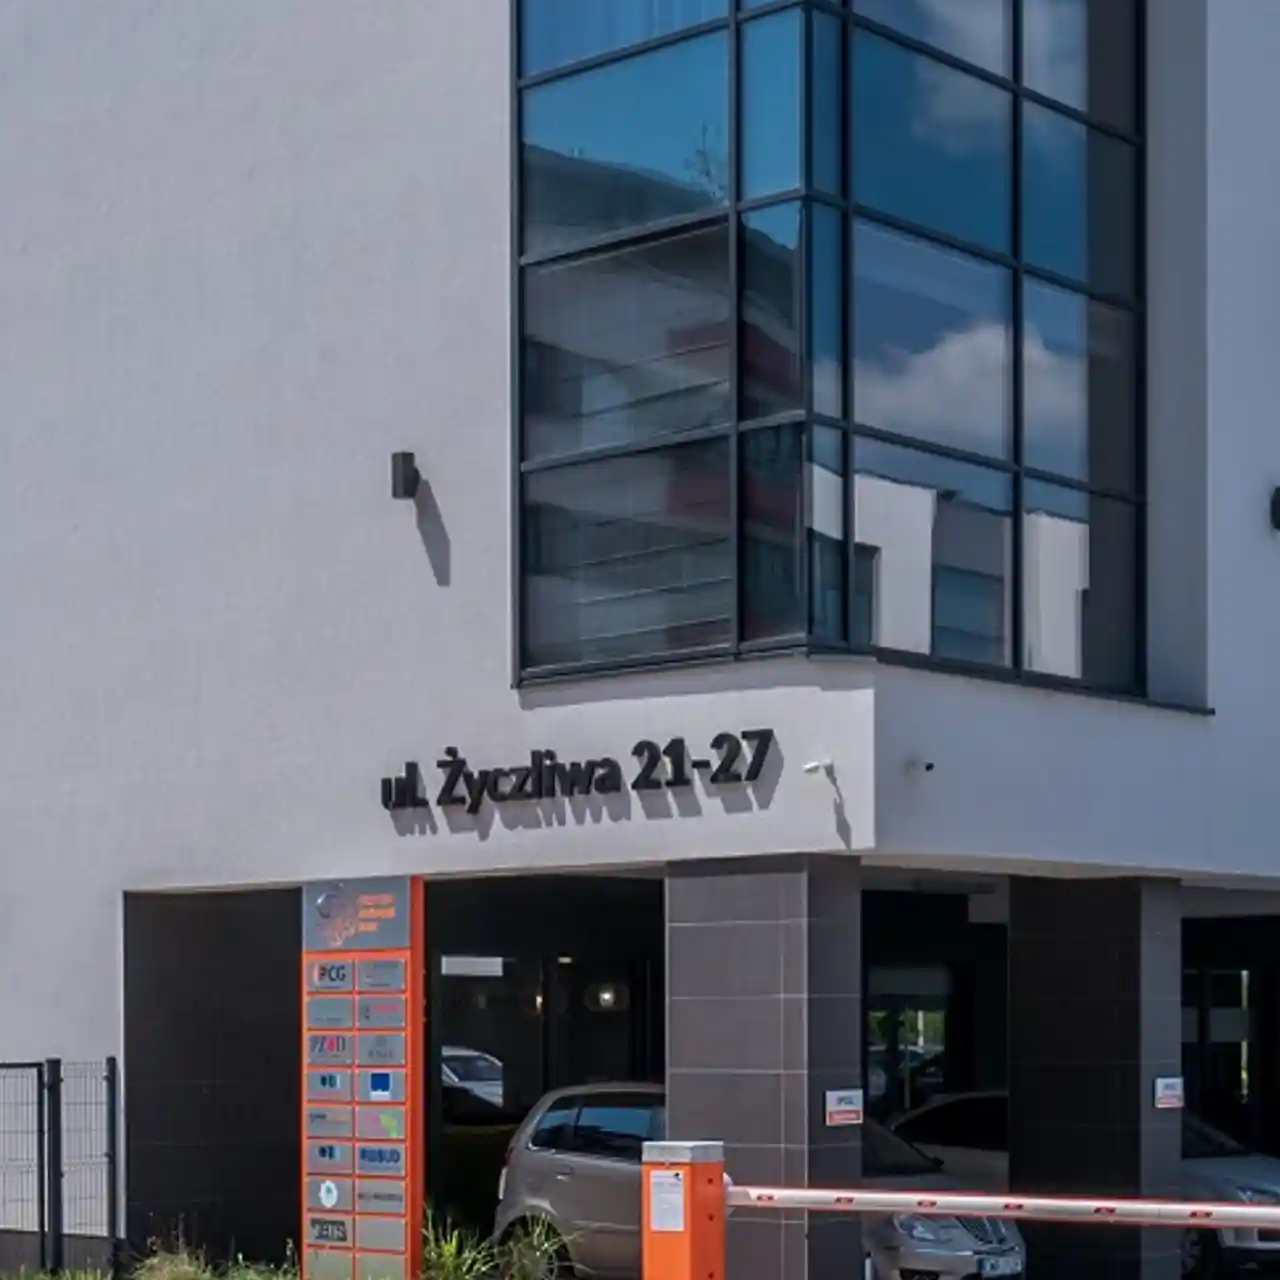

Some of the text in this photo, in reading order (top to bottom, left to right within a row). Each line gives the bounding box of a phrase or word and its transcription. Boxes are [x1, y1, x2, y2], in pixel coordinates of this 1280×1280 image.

[381, 728, 775, 814] ul. Życzliwa 21-27
[318, 964, 346, 983] PCG
